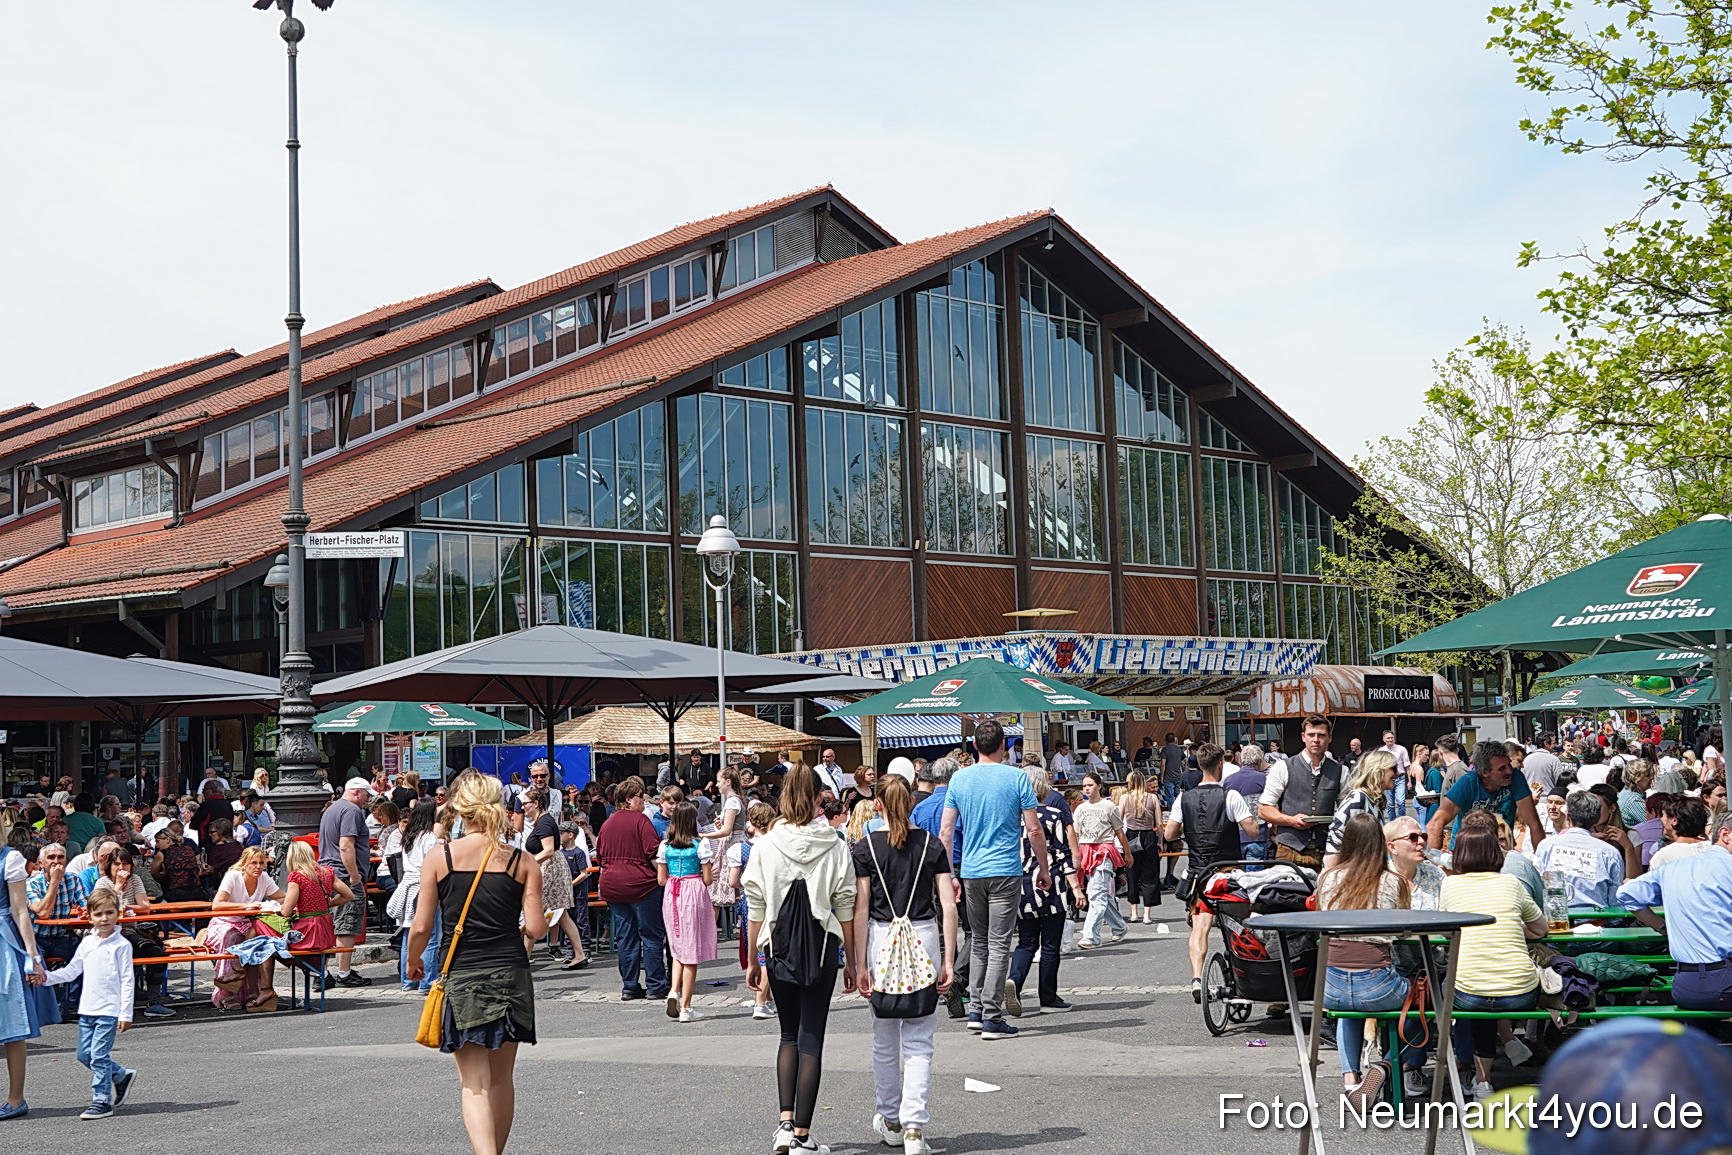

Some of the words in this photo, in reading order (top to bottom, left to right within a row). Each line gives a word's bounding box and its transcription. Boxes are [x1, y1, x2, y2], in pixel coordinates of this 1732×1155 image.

[309, 534, 399, 546] Herbert-Fischer-Platz
[1581, 598, 1702, 614] Neumarkter
[1551, 606, 1716, 628] Lammsbräu
[1098, 639, 1276, 671] Liebermann
[1368, 688, 1430, 700] PROSECCO-BAR
